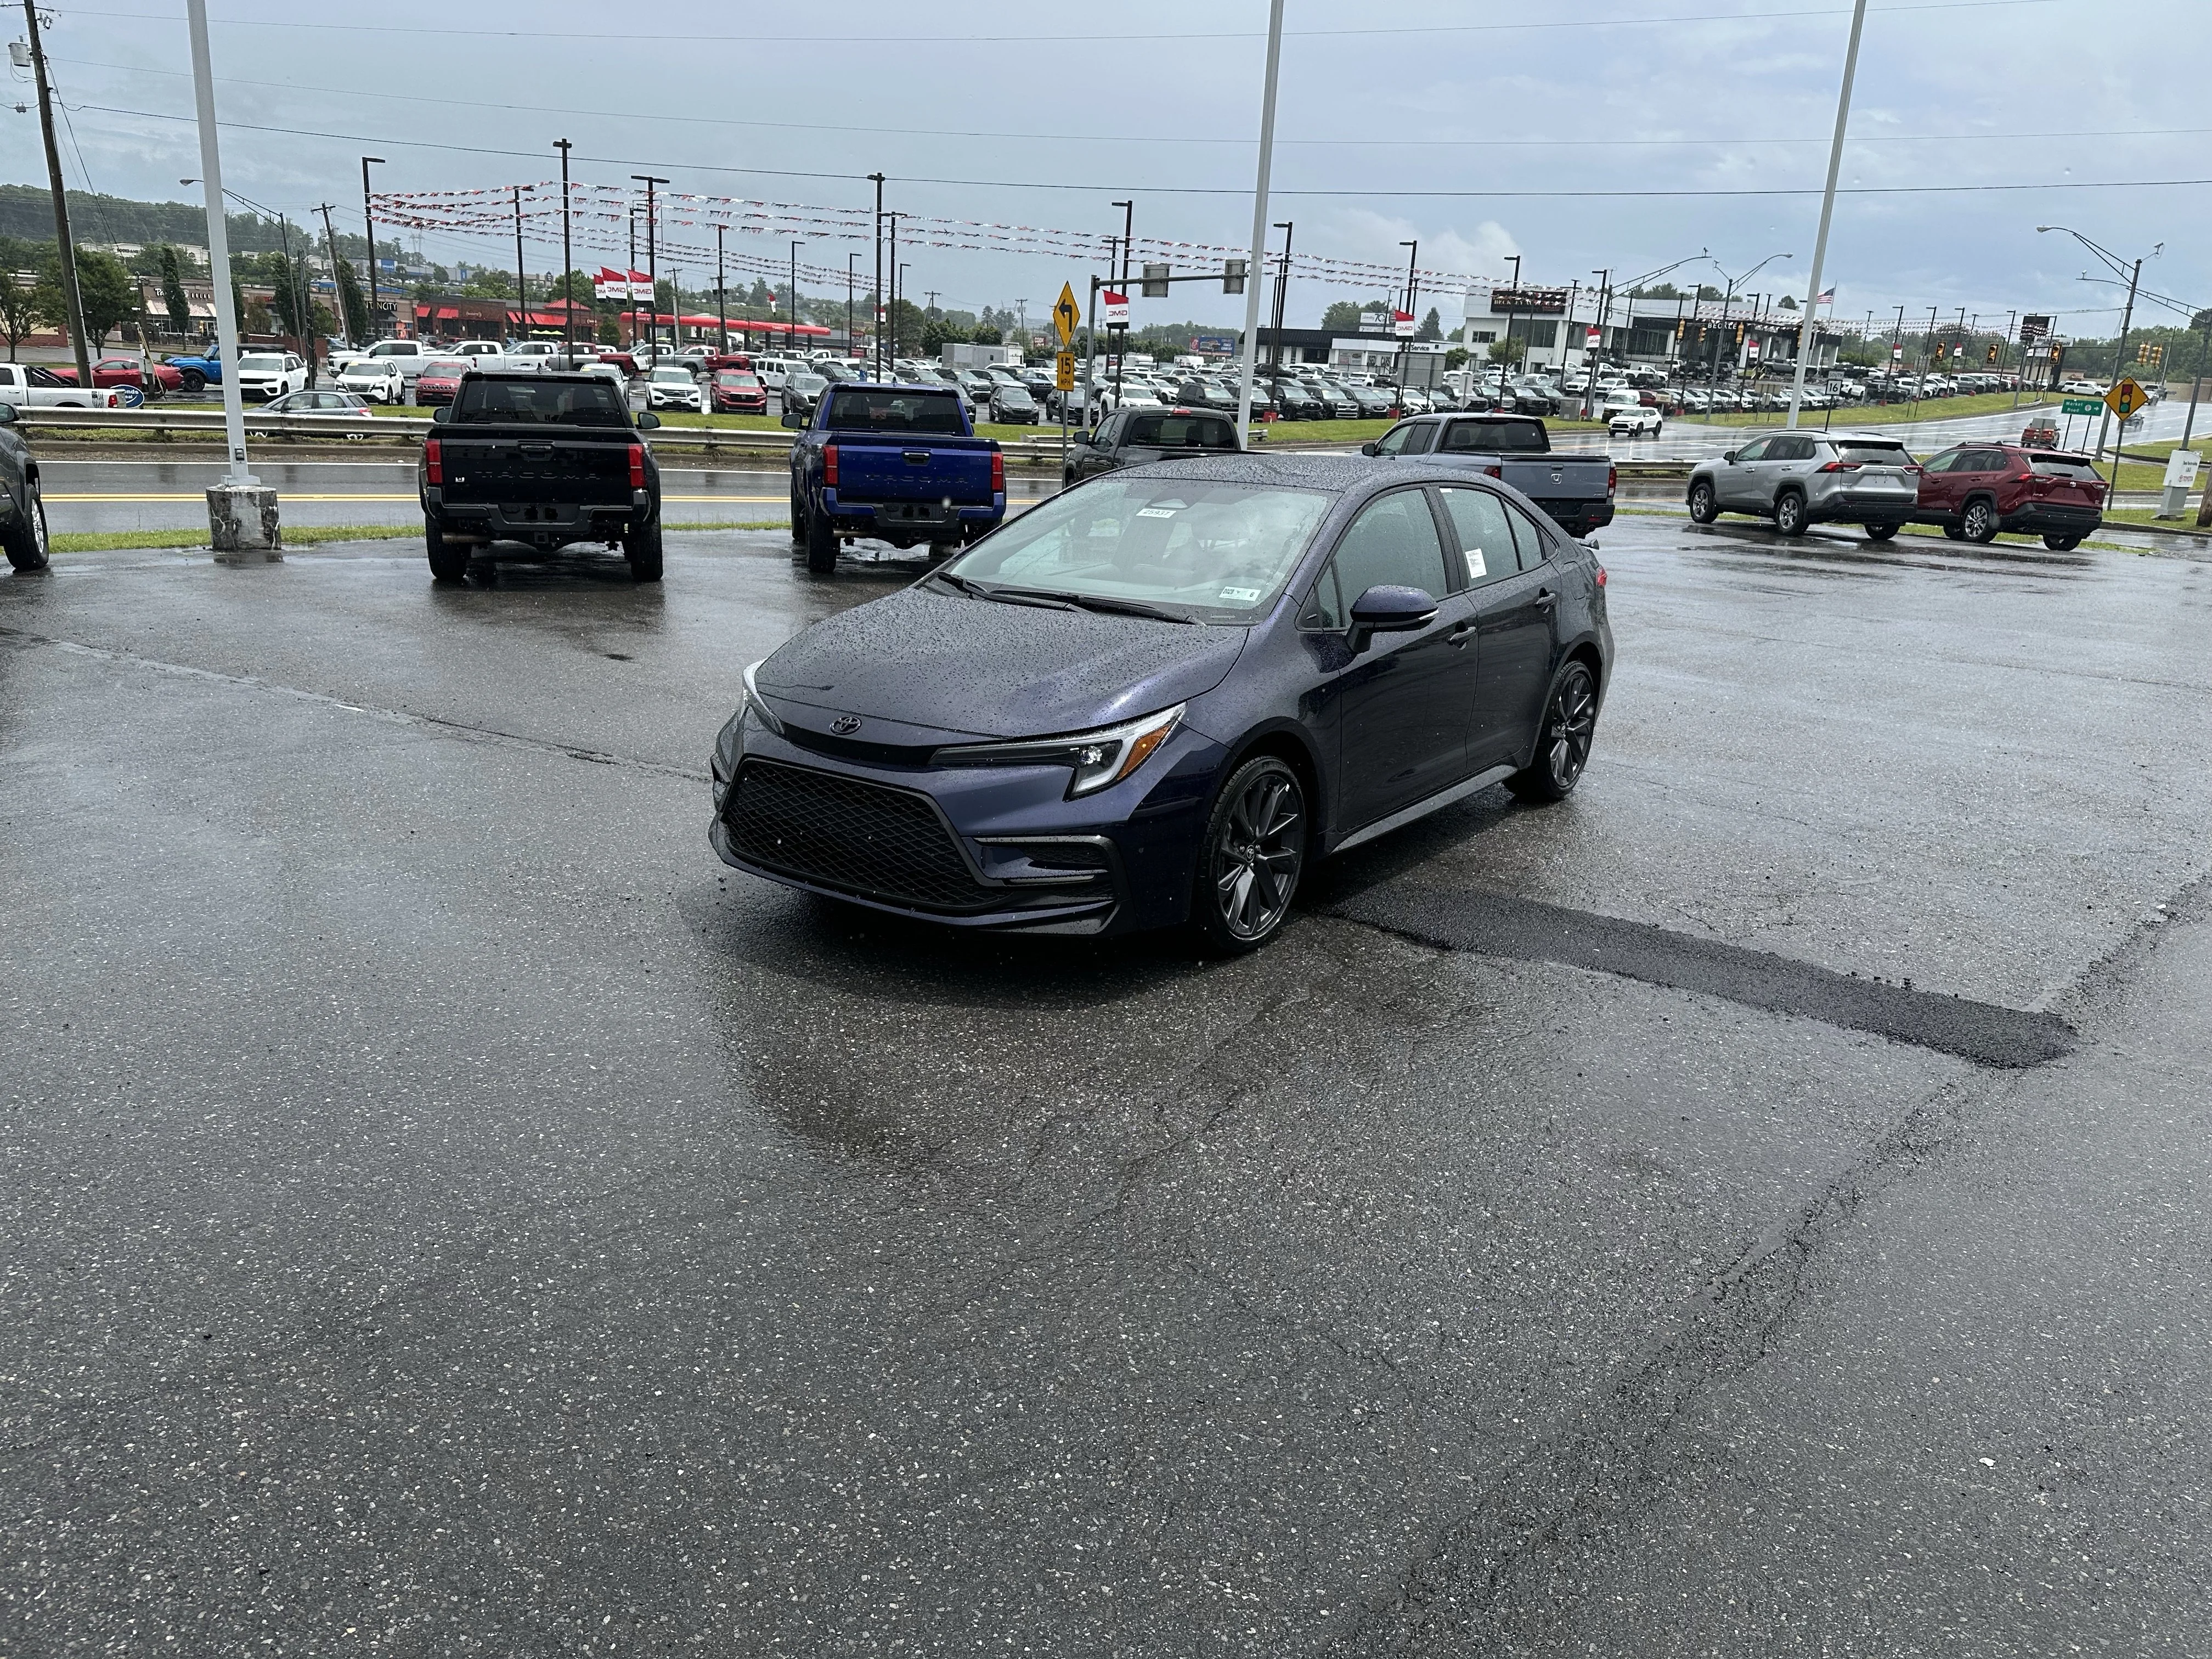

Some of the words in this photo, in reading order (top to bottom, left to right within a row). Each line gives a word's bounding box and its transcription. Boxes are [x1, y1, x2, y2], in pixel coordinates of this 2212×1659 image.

[1060, 357, 1071, 375] 15
[1830, 383, 1838, 392] 16
[474, 471, 601, 481] TACOMA
[865, 475, 969, 484] TACOMA
